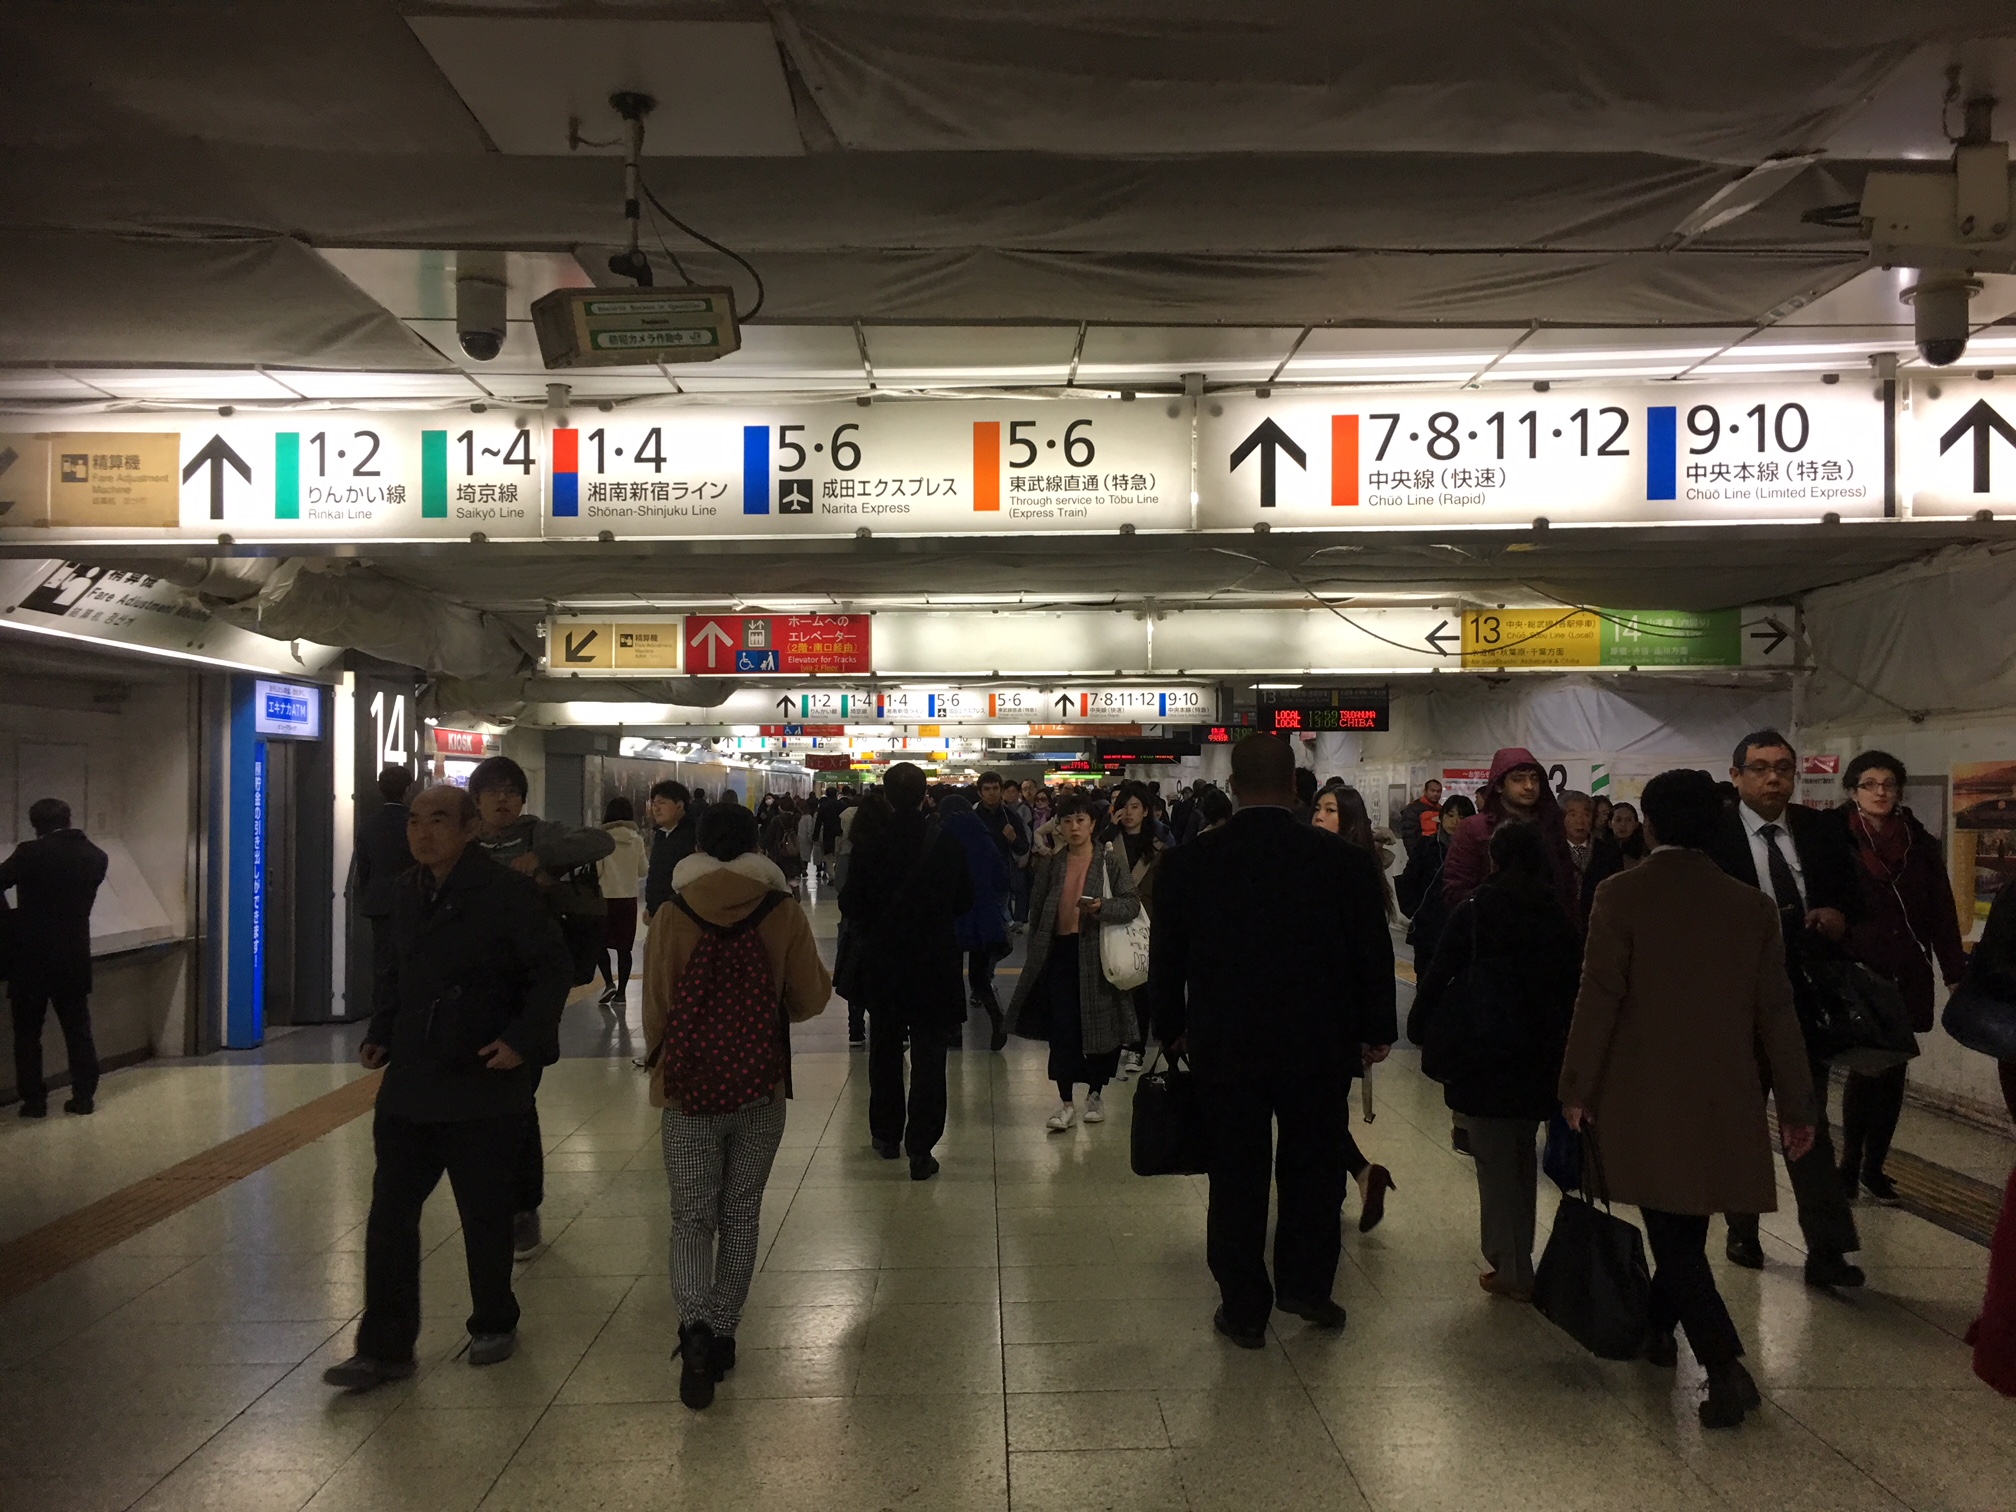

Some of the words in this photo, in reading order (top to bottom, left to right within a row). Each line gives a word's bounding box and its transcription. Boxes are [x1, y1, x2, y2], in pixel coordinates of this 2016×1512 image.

[92, 454, 140, 470] 精算機
[308, 484, 406, 504] りんかい線
[456, 484, 518, 504] 埼京線
[588, 481, 728, 502] 湘南新宿ライン
[822, 478, 958, 498] 成田エクスプレス
[1686, 488, 1720, 500] Chūō
[1725, 488, 1751, 499] Line
[1755, 486, 1808, 500] (Limited
[1810, 486, 1867, 500] Express)
[1009, 496, 1054, 508] Through
[1056, 496, 1093, 506] service
[1096, 495, 1105, 505] to
[1138, 494, 1159, 504] Line
[1368, 493, 1403, 506] Chūō
[1407, 493, 1434, 506] Line
[1438, 492, 1486, 508] (Rapid)
[308, 508, 344, 520] Rinkai
[348, 508, 372, 520] Line
[456, 506, 496, 522] Saikyō
[500, 508, 525, 518] Line
[588, 505, 688, 518] Shōnan-Shinjuku
[692, 504, 717, 516] Line
[822, 502, 859, 514] Narita
[862, 502, 910, 516] Express
[1009, 508, 1056, 520] (Express
[1058, 506, 1088, 519] Train)
[87, 588, 116, 602] Fare
[788, 616, 849, 628] ホームへの
[1612, 615, 1641, 642] 14
[788, 630, 856, 642] エレベーター
[1470, 616, 1500, 644] 13
[1262, 690, 1276, 704] 13
[268, 700, 306, 718] エキナカATM
[1276, 710, 1301, 720] LOCAL
[1309, 710, 1338, 719] 12:59
[1276, 720, 1301, 728] LOCAL
[1309, 719, 1338, 728] 13:05
[1340, 719, 1374, 728] CHIBA
[370, 691, 407, 782] 14
[448, 732, 472, 752] KIOSK
